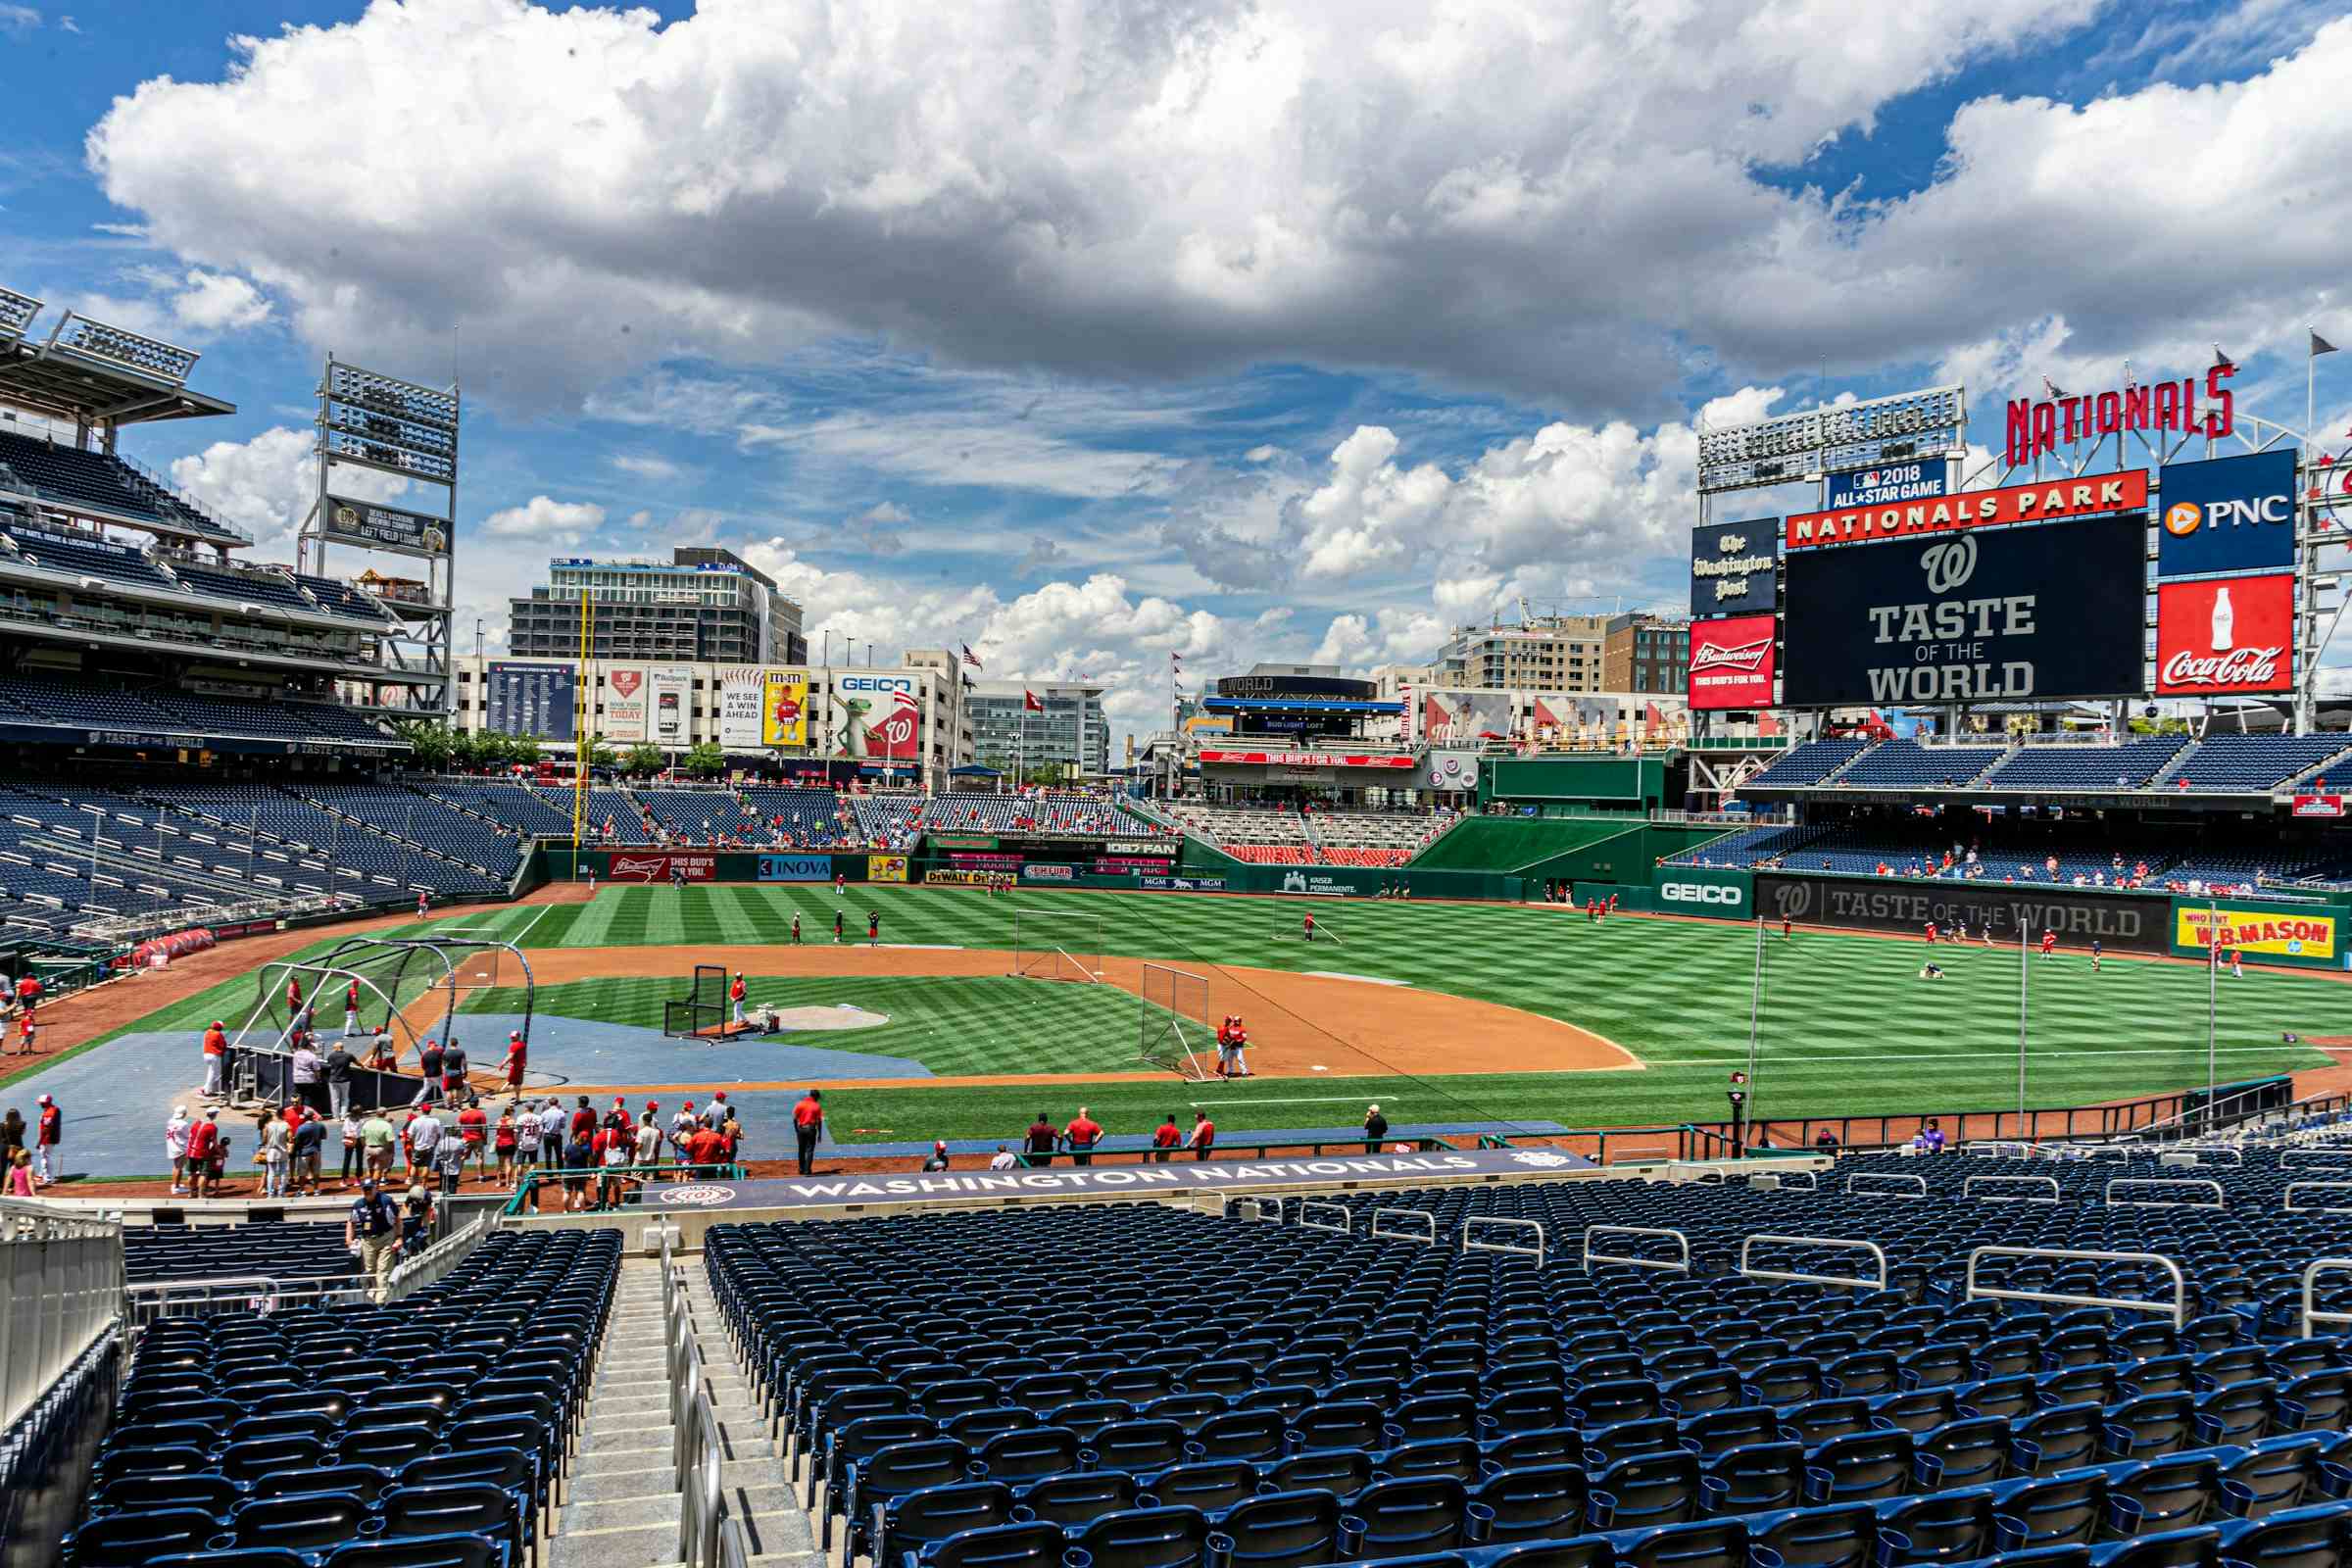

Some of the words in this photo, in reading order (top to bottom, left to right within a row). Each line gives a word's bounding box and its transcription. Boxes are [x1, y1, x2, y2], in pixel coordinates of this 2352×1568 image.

[2006, 363, 2233, 467] NATIONALS
[1883, 464, 1922, 483] 2018
[1900, 480, 1942, 499] GAME
[1795, 497, 1997, 539] NATIONALS
[2019, 480, 2124, 513] PARK
[2205, 495, 2288, 528] PNC
[361, 525, 378, 539] LEFT
[379, 529, 399, 542] FIELD
[1720, 534, 1746, 553] The
[1693, 555, 1773, 576] Washington
[1716, 578, 1748, 601] Post
[1869, 595, 2035, 643] TASTE
[1698, 647, 1764, 663] Budweiser
[1915, 645, 1940, 662] OF
[1944, 642, 1984, 660] THE
[2163, 647, 2283, 686] Coca-Cola
[843, 677, 910, 692] GEICO
[1227, 677, 1274, 691] WORLD
[1694, 676, 1711, 685] THIS
[1734, 675, 1748, 684] FOR
[1867, 661, 2034, 702] WORLD
[105, 732, 139, 745] TASTE
[165, 736, 205, 748] WORLD
[301, 744, 333, 755] TASTE
[354, 747, 387, 757] WORLD
[1266, 753, 1284, 763] THIS
[1143, 844, 1176, 854] FAN
[670, 858, 688, 866] THIS
[690, 858, 714, 866] BUD'S
[687, 867, 706, 876] YOU.
[777, 861, 829, 874] INOVA
[1661, 883, 1742, 905] GEICO
[1832, 891, 1930, 921] TASTE
[1933, 904, 1960, 922] OF
[1966, 905, 2006, 926] THE
[2010, 903, 2141, 937] WORLD
[2185, 914, 2207, 923] WHO
[789, 1169, 1179, 1199] WASHINGTON
[1186, 1155, 1479, 1184] NATIONALS
